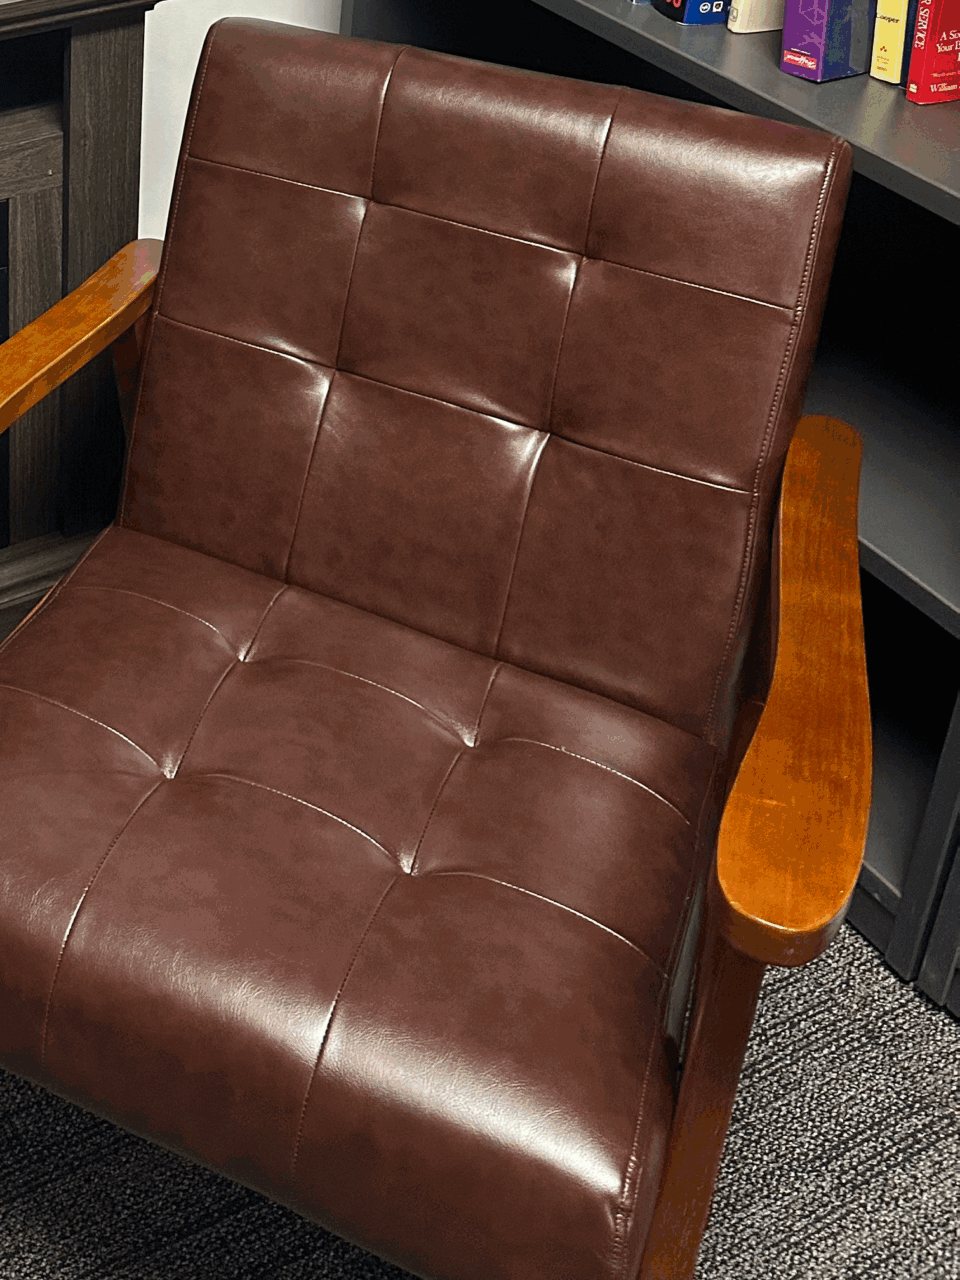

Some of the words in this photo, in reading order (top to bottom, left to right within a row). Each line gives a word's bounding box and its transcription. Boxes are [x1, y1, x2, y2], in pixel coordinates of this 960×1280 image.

[915, 7, 930, 50] SERVICE
[940, 31, 947, 41] A
[936, 43, 954, 53] Your
